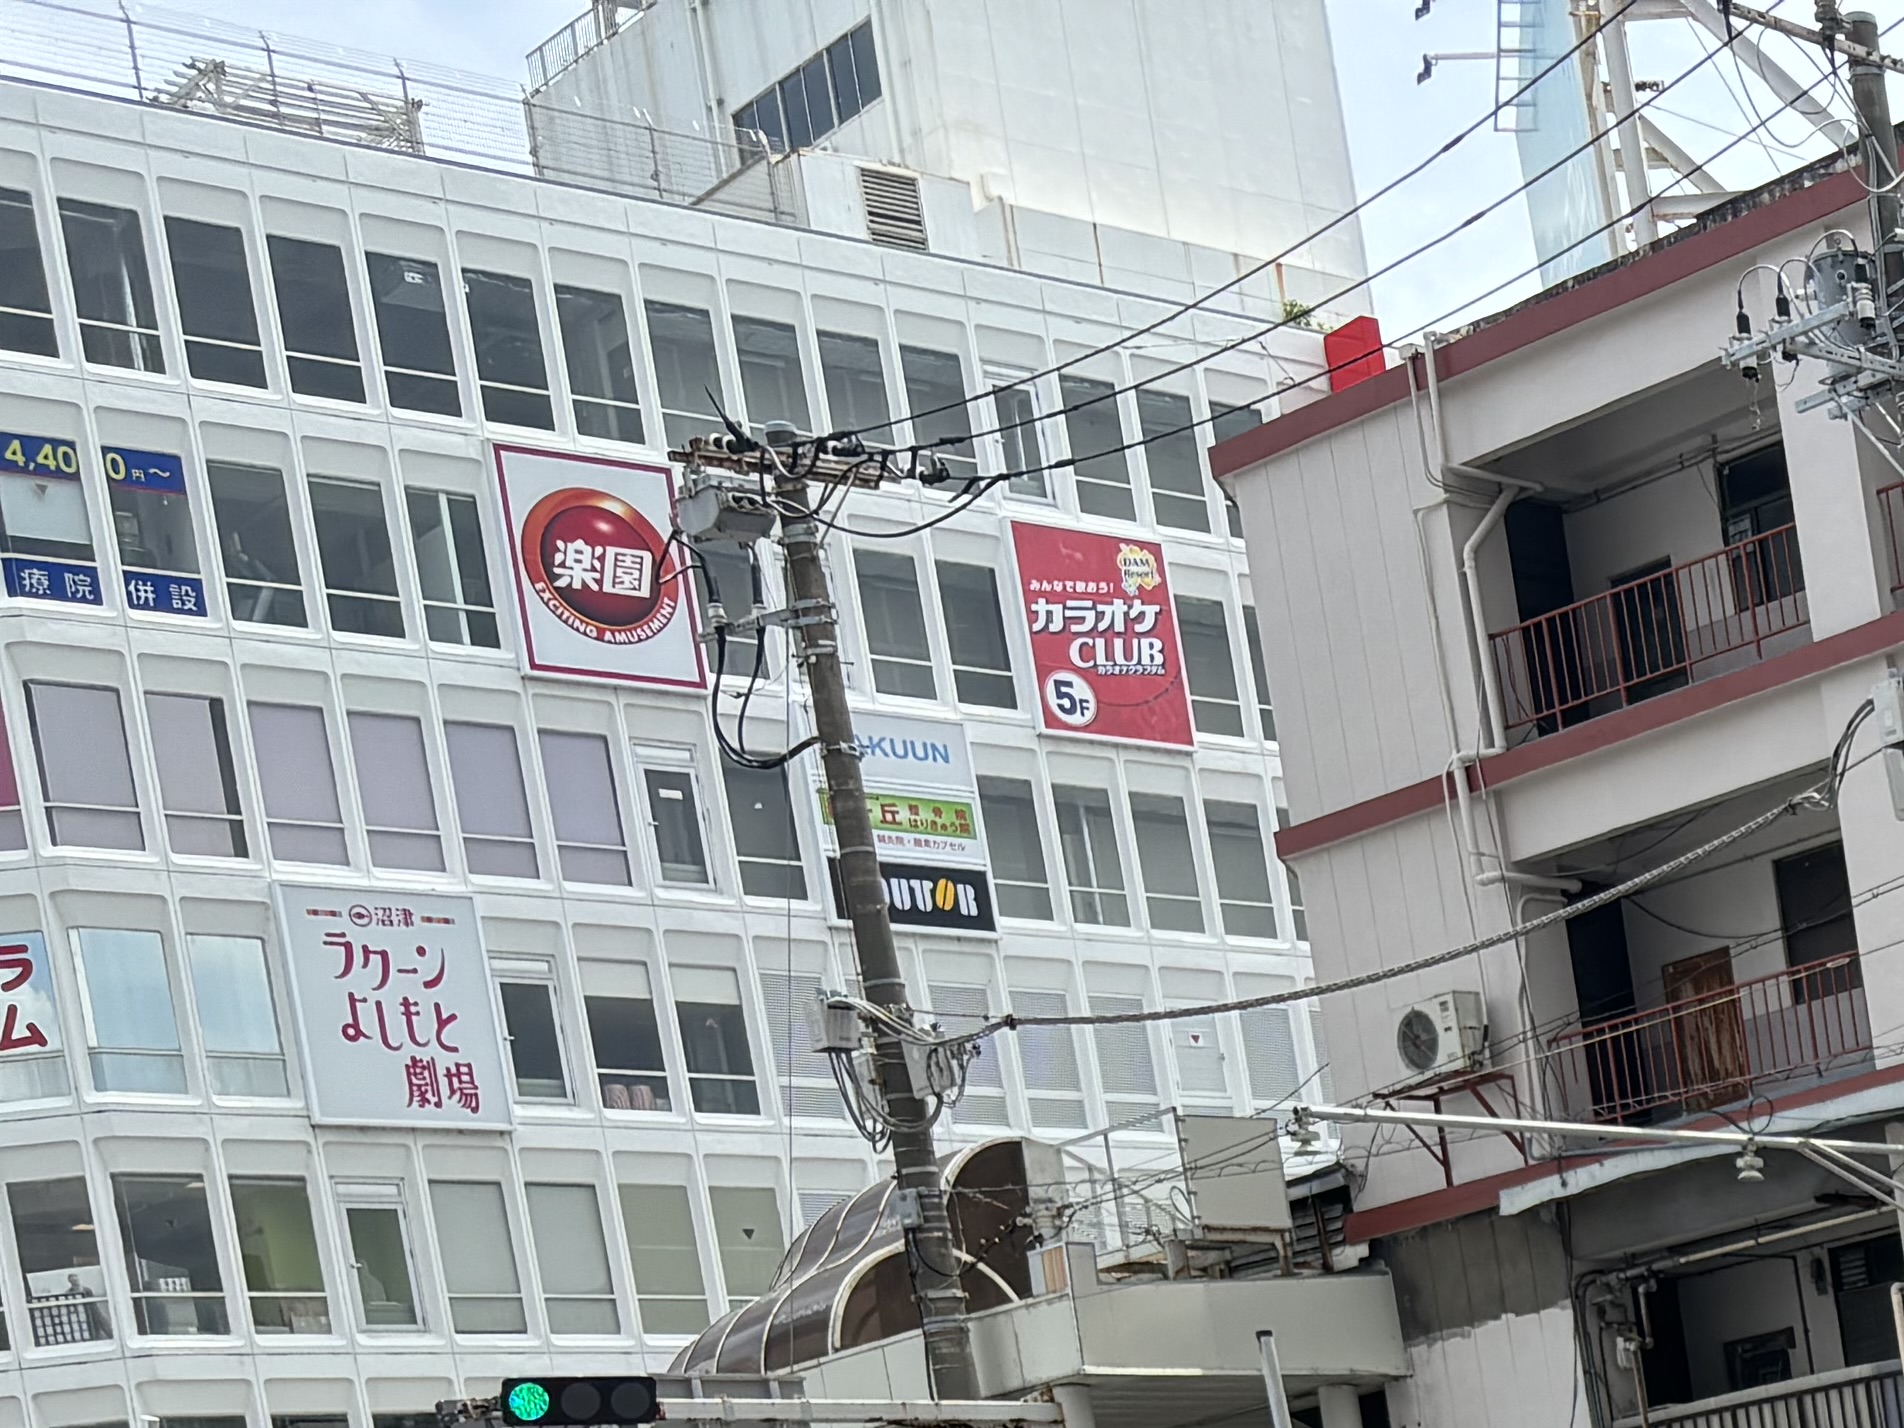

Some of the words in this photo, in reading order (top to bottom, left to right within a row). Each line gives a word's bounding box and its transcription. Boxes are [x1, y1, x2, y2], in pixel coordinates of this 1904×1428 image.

[552, 538, 653, 599] 楽園
[533, 581, 599, 642] EXCITING
[602, 595, 679, 645] AMUSEMENT
[1030, 597, 1162, 635] カラオケ
[1068, 637, 1166, 670] CLUB
[1053, 678, 1091, 718] 5F
[373, 906, 415, 928] 沼津
[322, 931, 446, 991] ラクーン
[341, 991, 460, 1053] よしもと
[404, 1055, 480, 1114] 劇場
